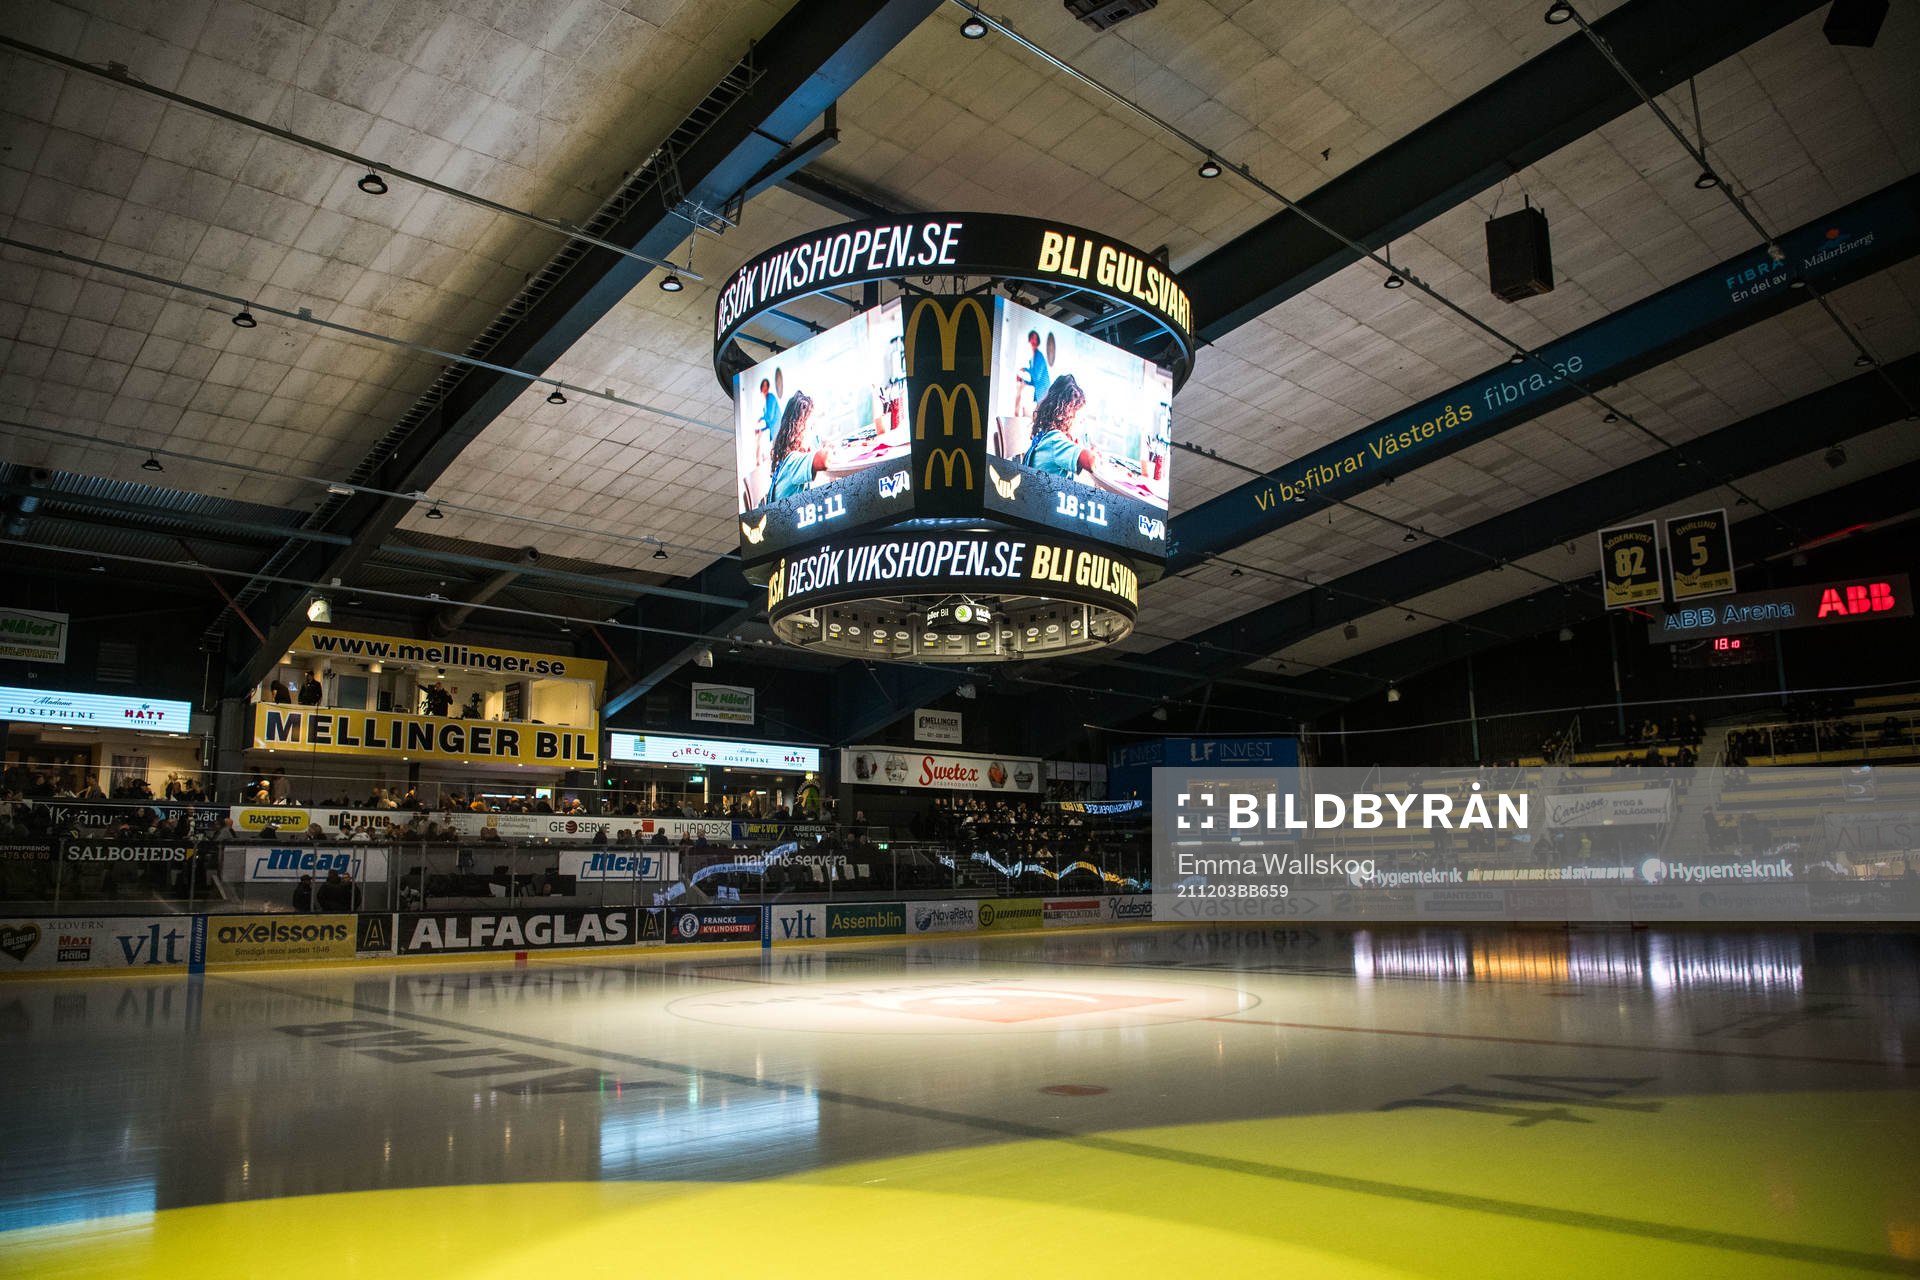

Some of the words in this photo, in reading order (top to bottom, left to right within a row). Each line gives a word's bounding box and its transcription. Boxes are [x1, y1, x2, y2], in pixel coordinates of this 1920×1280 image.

[1037, 231, 1093, 280] BLI
[1803, 231, 1875, 269] MälarEnergi
[717, 265, 759, 341] BESÖK
[760, 222, 963, 302] VIKSHOPEN.SE
[1731, 291, 1749, 303] En
[1750, 279, 1771, 295] del
[1773, 272, 1788, 286] av
[1482, 353, 1584, 411] fibra.se
[1254, 489, 1276, 512] Vi
[1368, 403, 1473, 460] Västerås
[797, 494, 847, 530] 18:11
[1056, 491, 1108, 526] 18:11
[1031, 545, 1074, 583] BLI
[1614, 545, 1646, 577] 82
[1689, 535, 1709, 568] 5
[787, 545, 844, 597] BESÖK
[846, 540, 1026, 583] VIKSHOPEN.SE
[1816, 582, 1896, 618] ABB
[1664, 608, 1716, 631] ABB
[1722, 602, 1795, 625] Arena
[312, 635, 566, 676] www.mellinger.se
[33, 696, 73, 707] Madame
[697, 691, 719, 704] City
[8, 705, 96, 720] JOSEPHINE
[124, 709, 165, 721] HATT
[265, 710, 521, 758] MELLINGER
[535, 731, 596, 762] BIL
[671, 746, 717, 761] CIRCUS
[784, 755, 806, 764] HATT
[1189, 742, 1216, 762] LF
[1219, 742, 1273, 758] INVEST
[918, 756, 979, 786] Swetex
[1612, 800, 1635, 808] BYGG
[249, 815, 302, 825] RAMIRENT
[360, 815, 390, 828] BYGG
[68, 846, 185, 862] SALBOHEDS
[1372, 867, 1463, 887] Hygienteknik
[1668, 859, 1794, 881] Hygienteknik
[703, 916, 736, 925] FRANCKS
[779, 909, 817, 939] vlt
[831, 912, 903, 930] Assemblin
[933, 907, 973, 921] NovaReko
[996, 908, 1042, 919] WARRIOR
[218, 921, 348, 944] axelssons
[408, 912, 628, 951] ALFAGLAS
[703, 925, 750, 935] KYLINDUSTRI
[59, 950, 90, 961] Hälla
[116, 923, 185, 965] vlt
